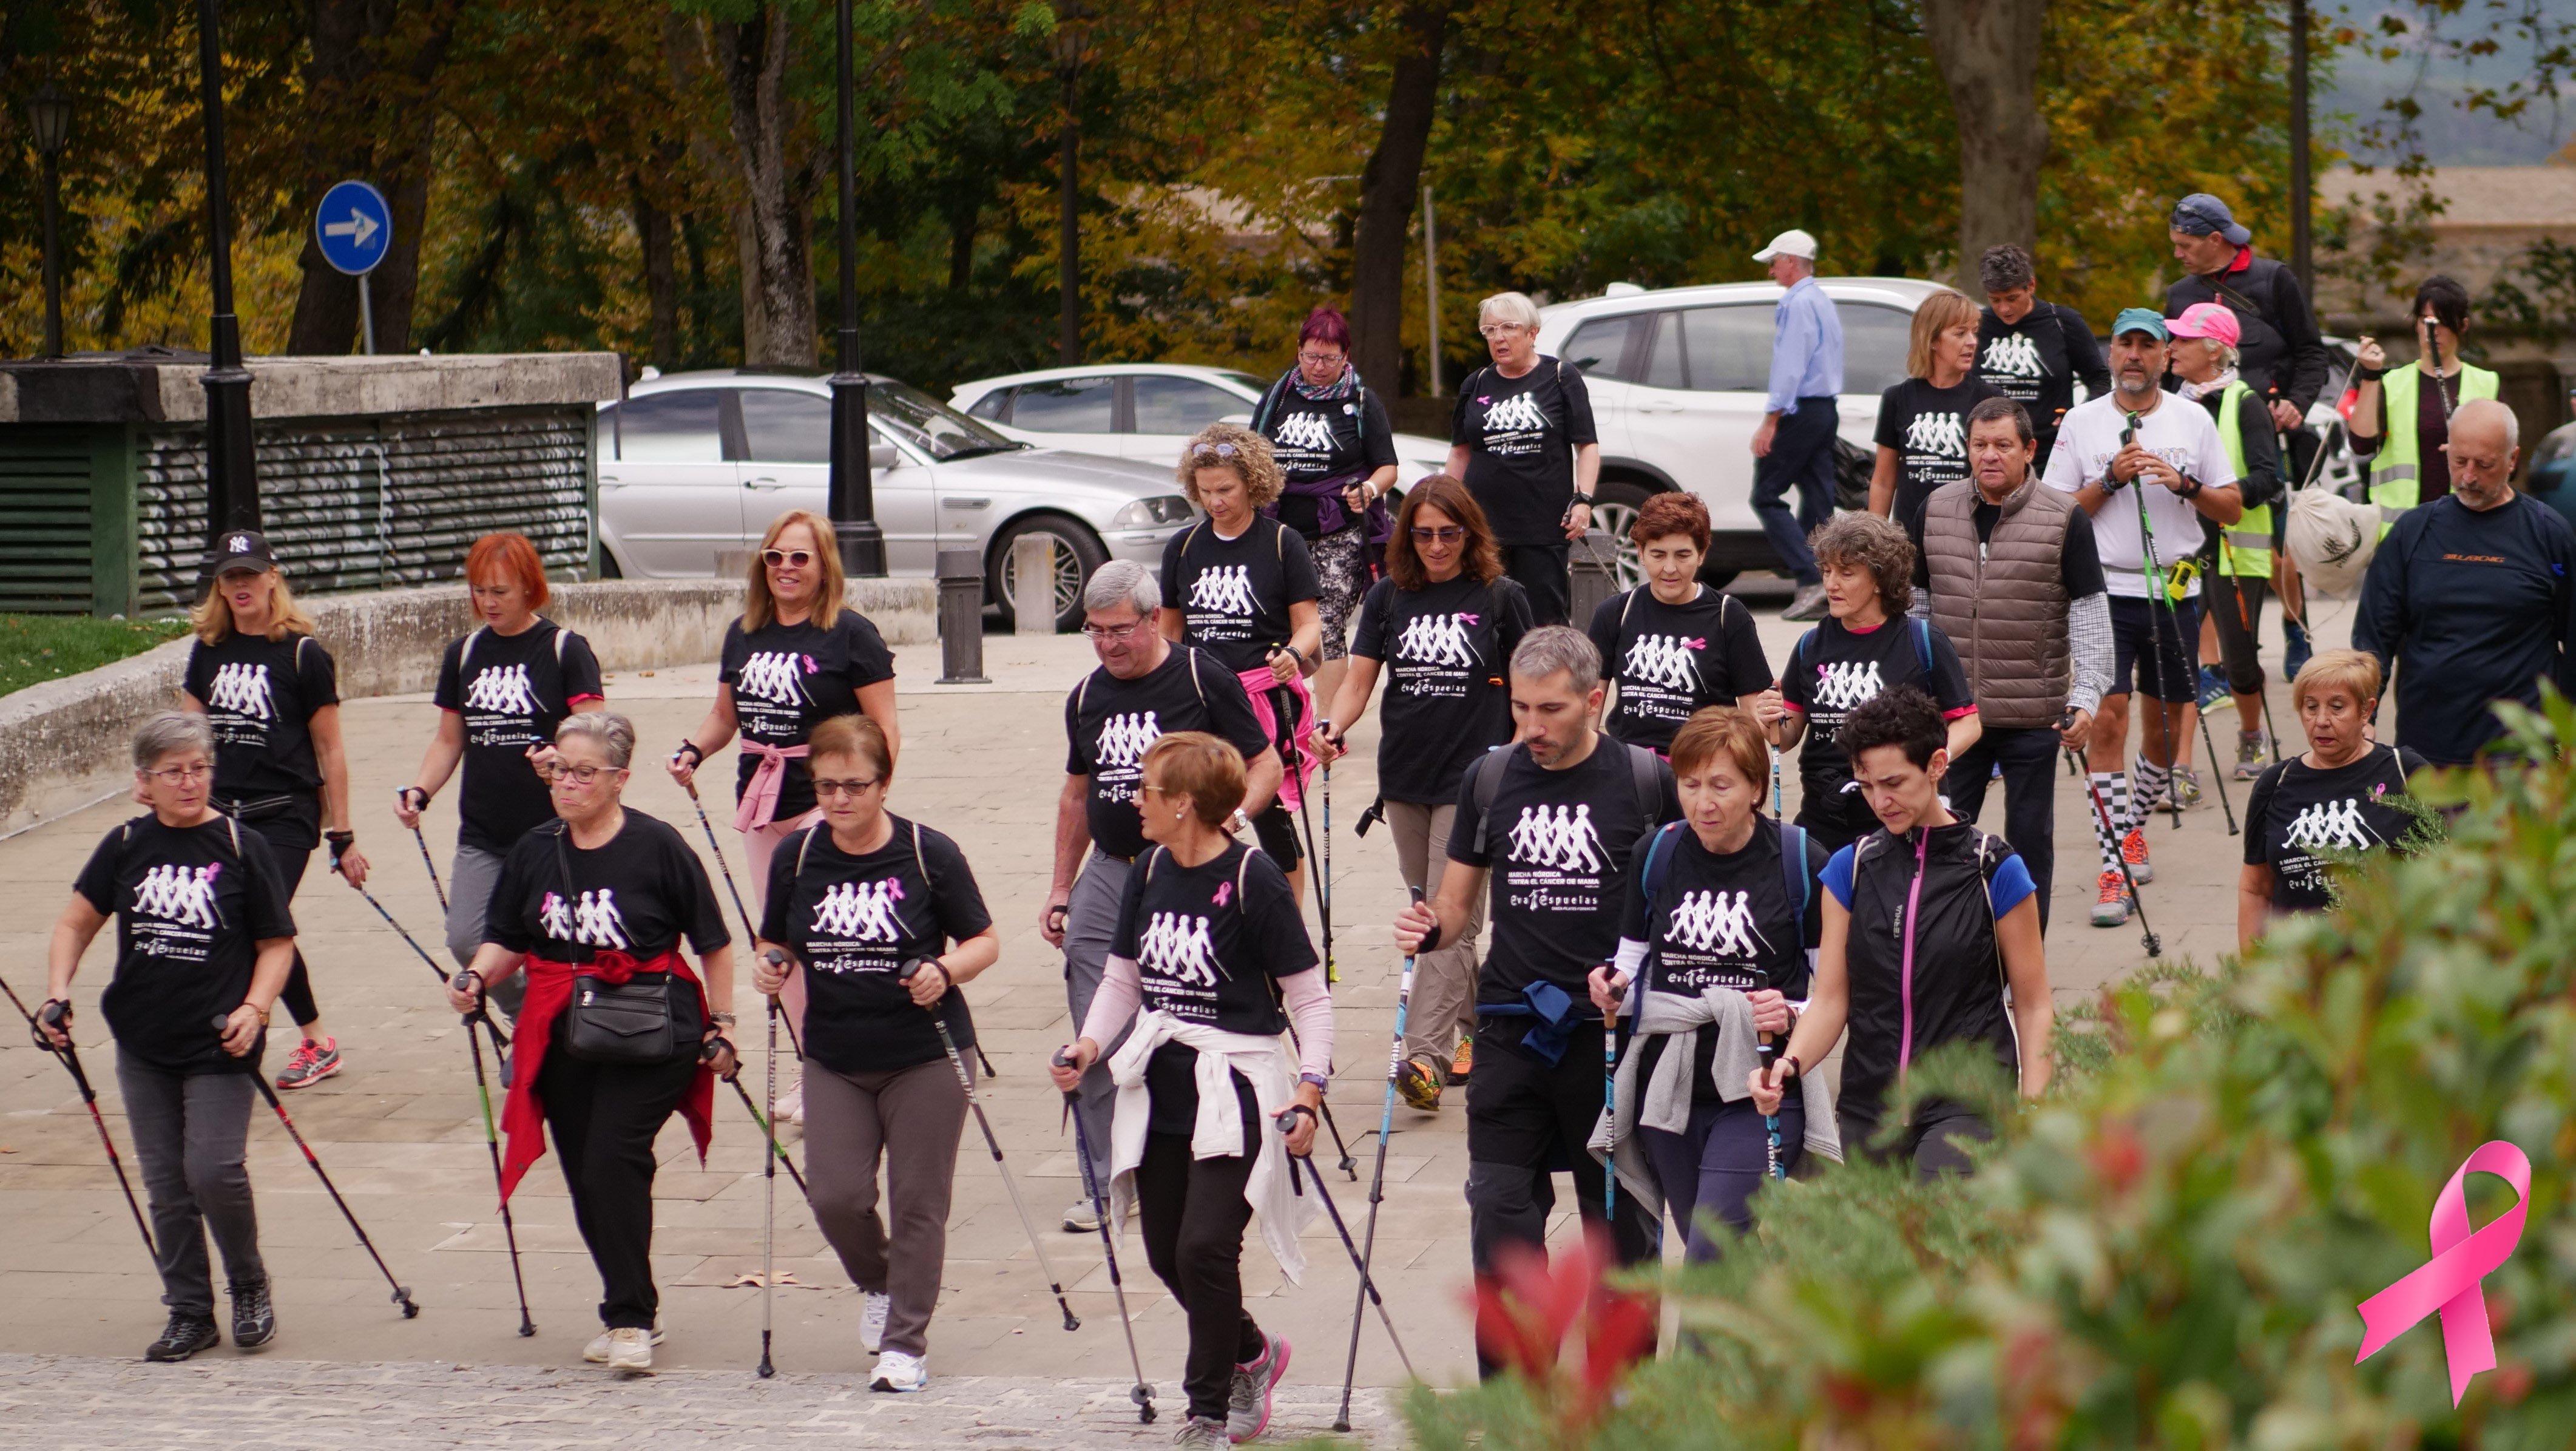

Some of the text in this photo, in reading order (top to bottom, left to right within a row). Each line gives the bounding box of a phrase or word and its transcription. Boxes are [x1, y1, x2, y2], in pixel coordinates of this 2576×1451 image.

[1401, 683, 1466, 692] eva espuelas
[1623, 705, 1689, 716] eva espuelas
[2284, 856, 2309, 864] MARCHA
[2289, 879, 2305, 889] eva
[1510, 895, 1598, 905] eva espuelas
[1893, 904, 1902, 939] TERNUA
[814, 959, 898, 970] eva espuelas
[1668, 973, 1754, 984] eva espuelas
[1388, 1041, 1401, 1078] iwalk
[946, 1047, 978, 1104] ULTRALITE
